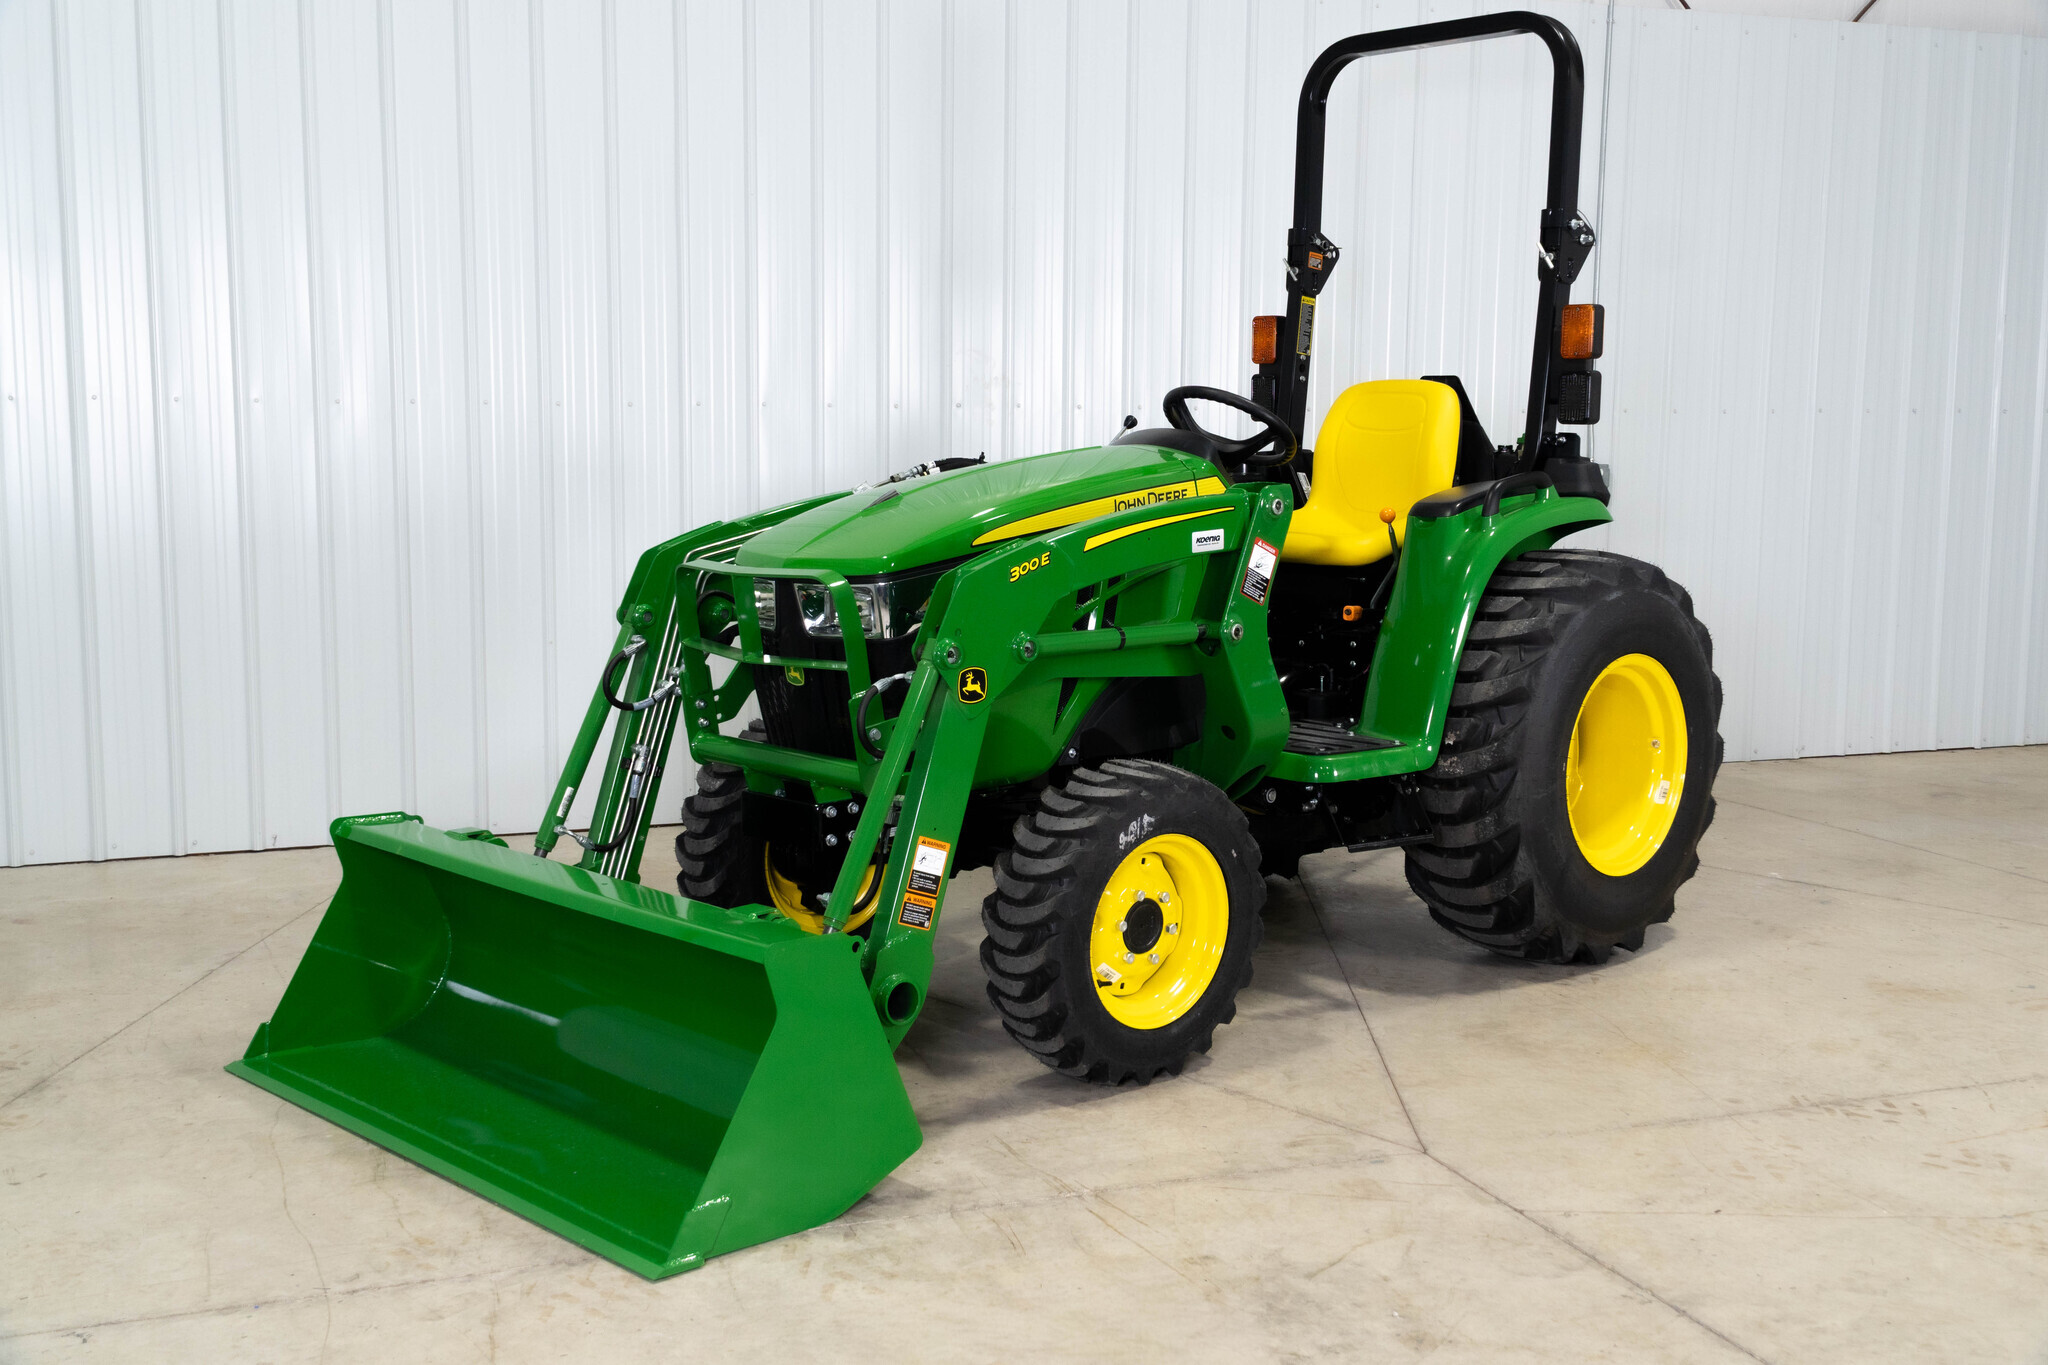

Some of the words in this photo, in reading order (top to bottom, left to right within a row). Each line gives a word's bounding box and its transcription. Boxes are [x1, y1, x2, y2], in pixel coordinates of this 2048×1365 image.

[1114, 496, 1145, 512] JOHN
[1148, 489, 1188, 504] DEERE
[1009, 557, 1040, 583] 300
[1041, 551, 1051, 567] E
[926, 841, 947, 850] WARNING
[913, 897, 933, 907] WARNING
